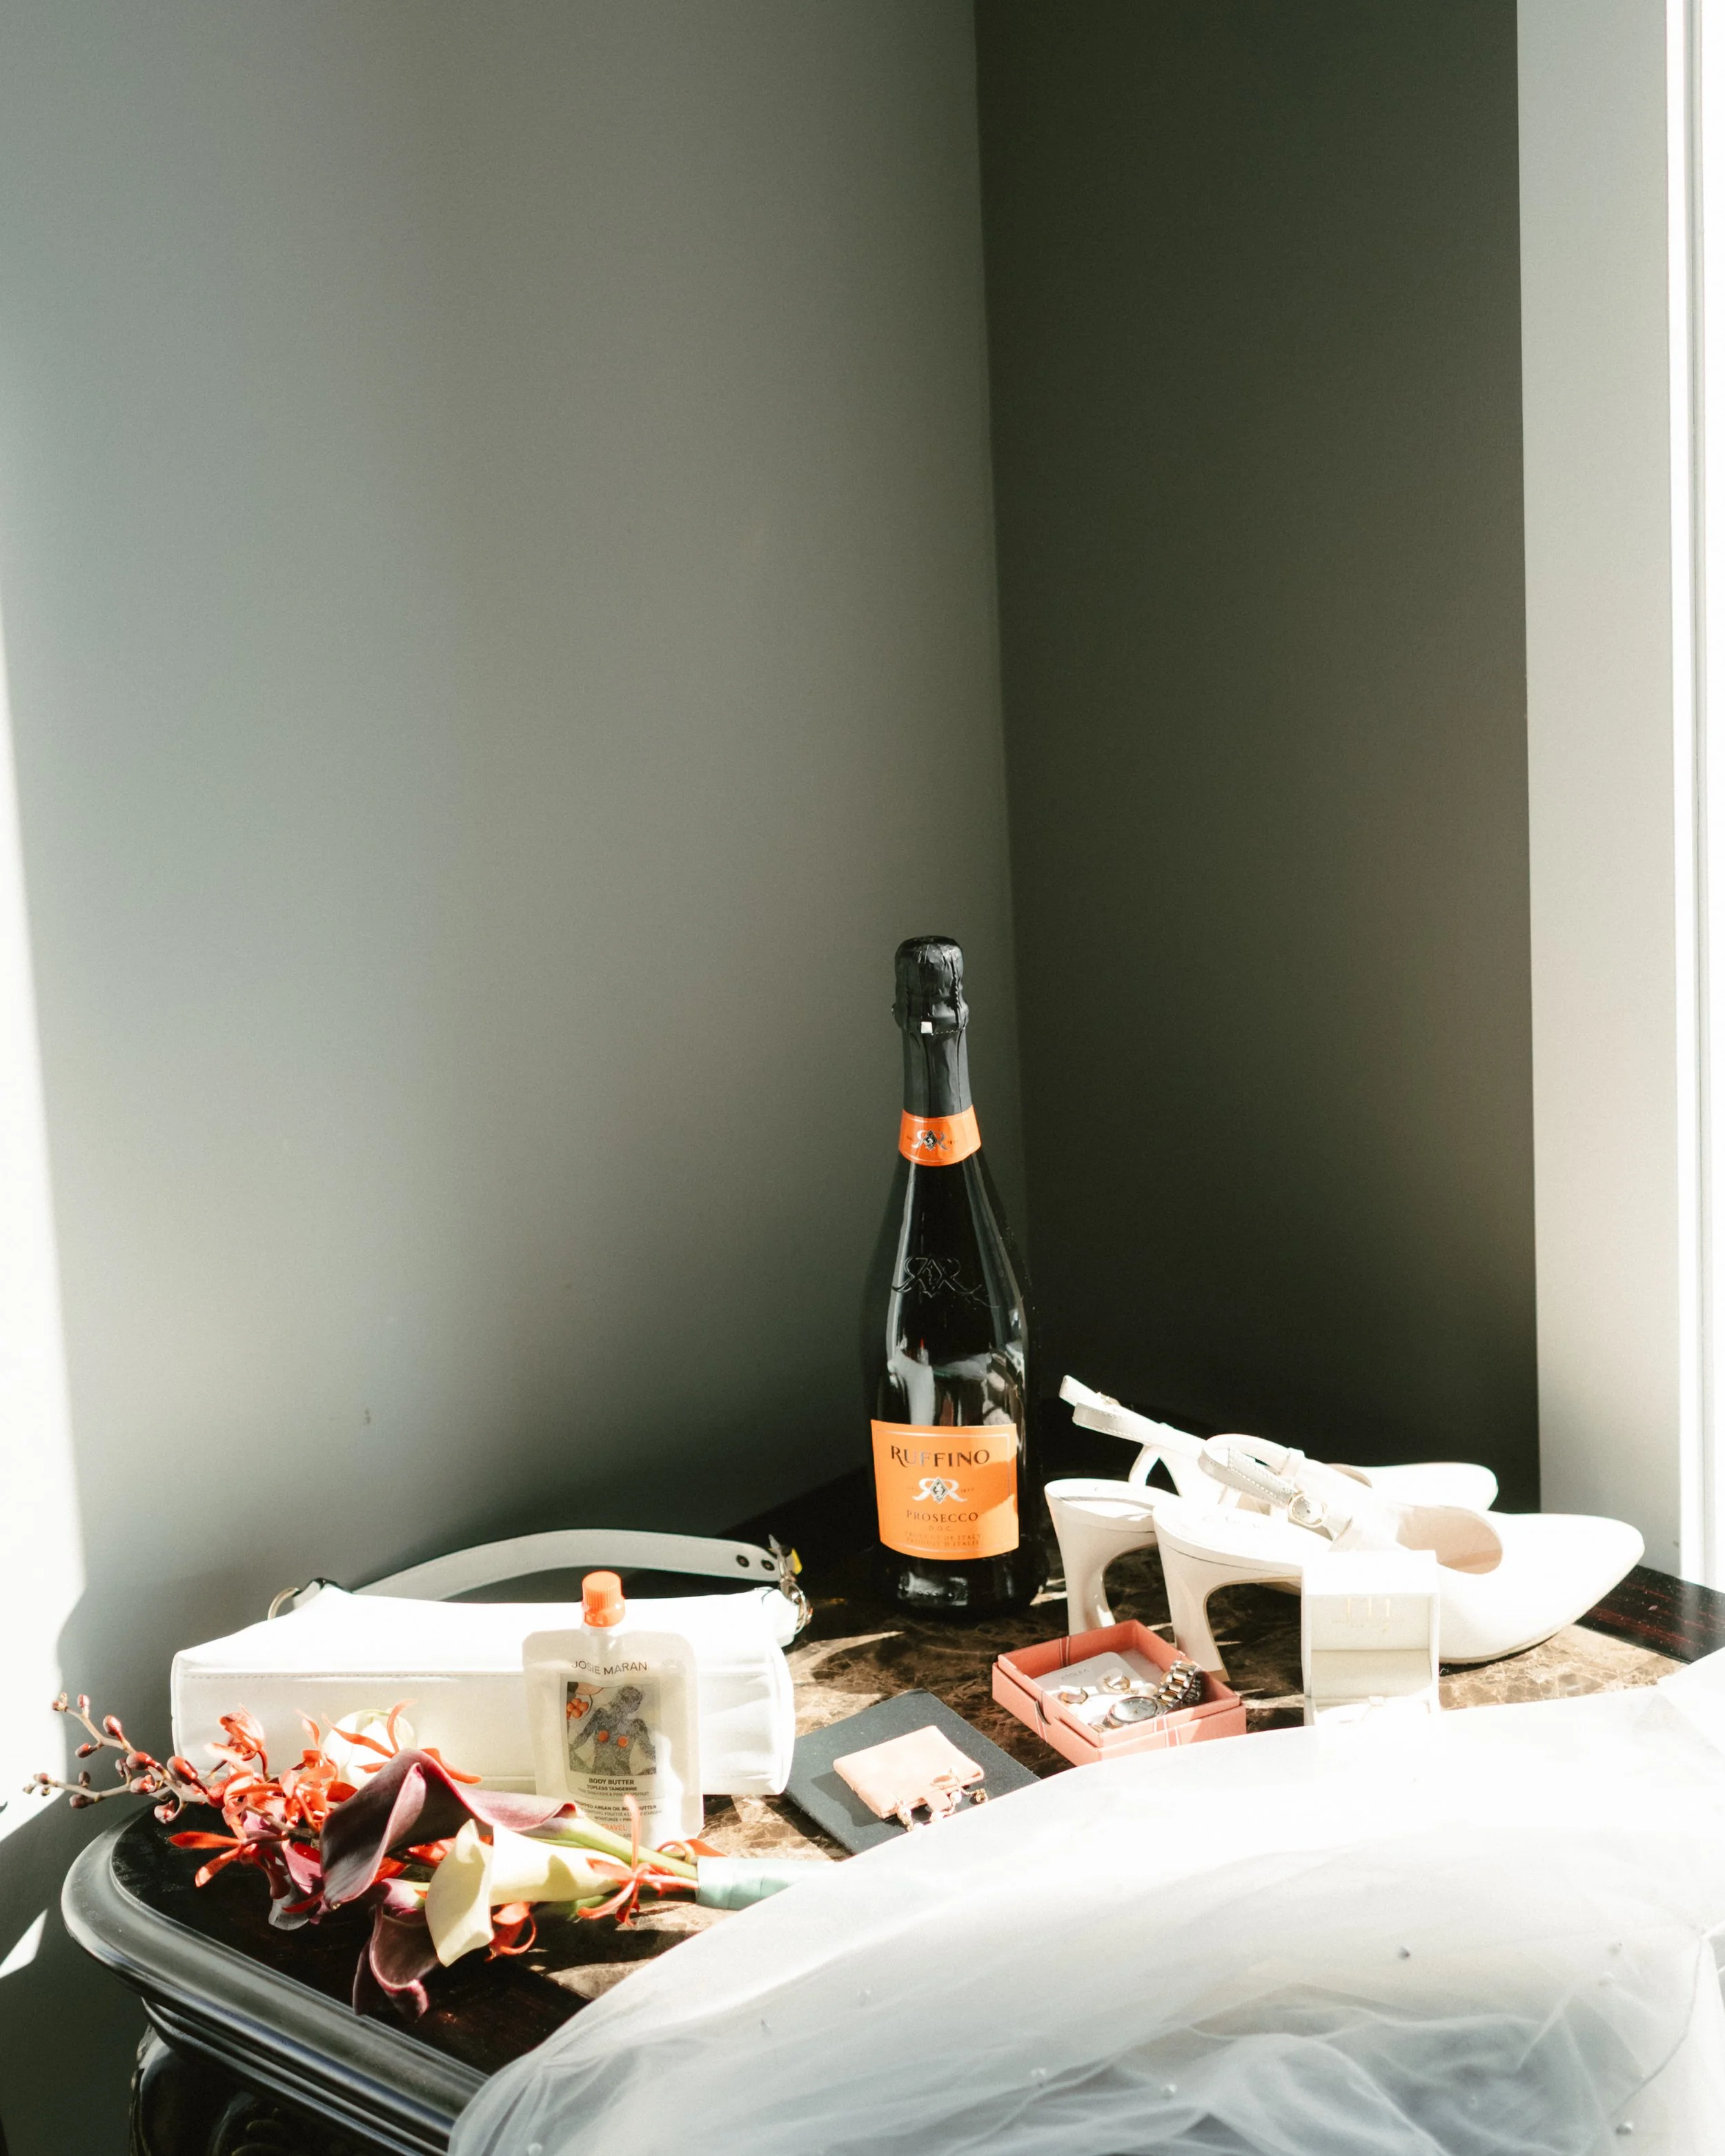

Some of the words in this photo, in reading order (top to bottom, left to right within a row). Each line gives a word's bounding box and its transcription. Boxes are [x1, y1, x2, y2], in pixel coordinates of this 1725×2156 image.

[891, 1445, 990, 1467] RUFFINO
[906, 1510, 978, 1523] PROSECCO
[571, 1661, 601, 1675] JOSIE
[603, 1661, 647, 1675] MARAN
